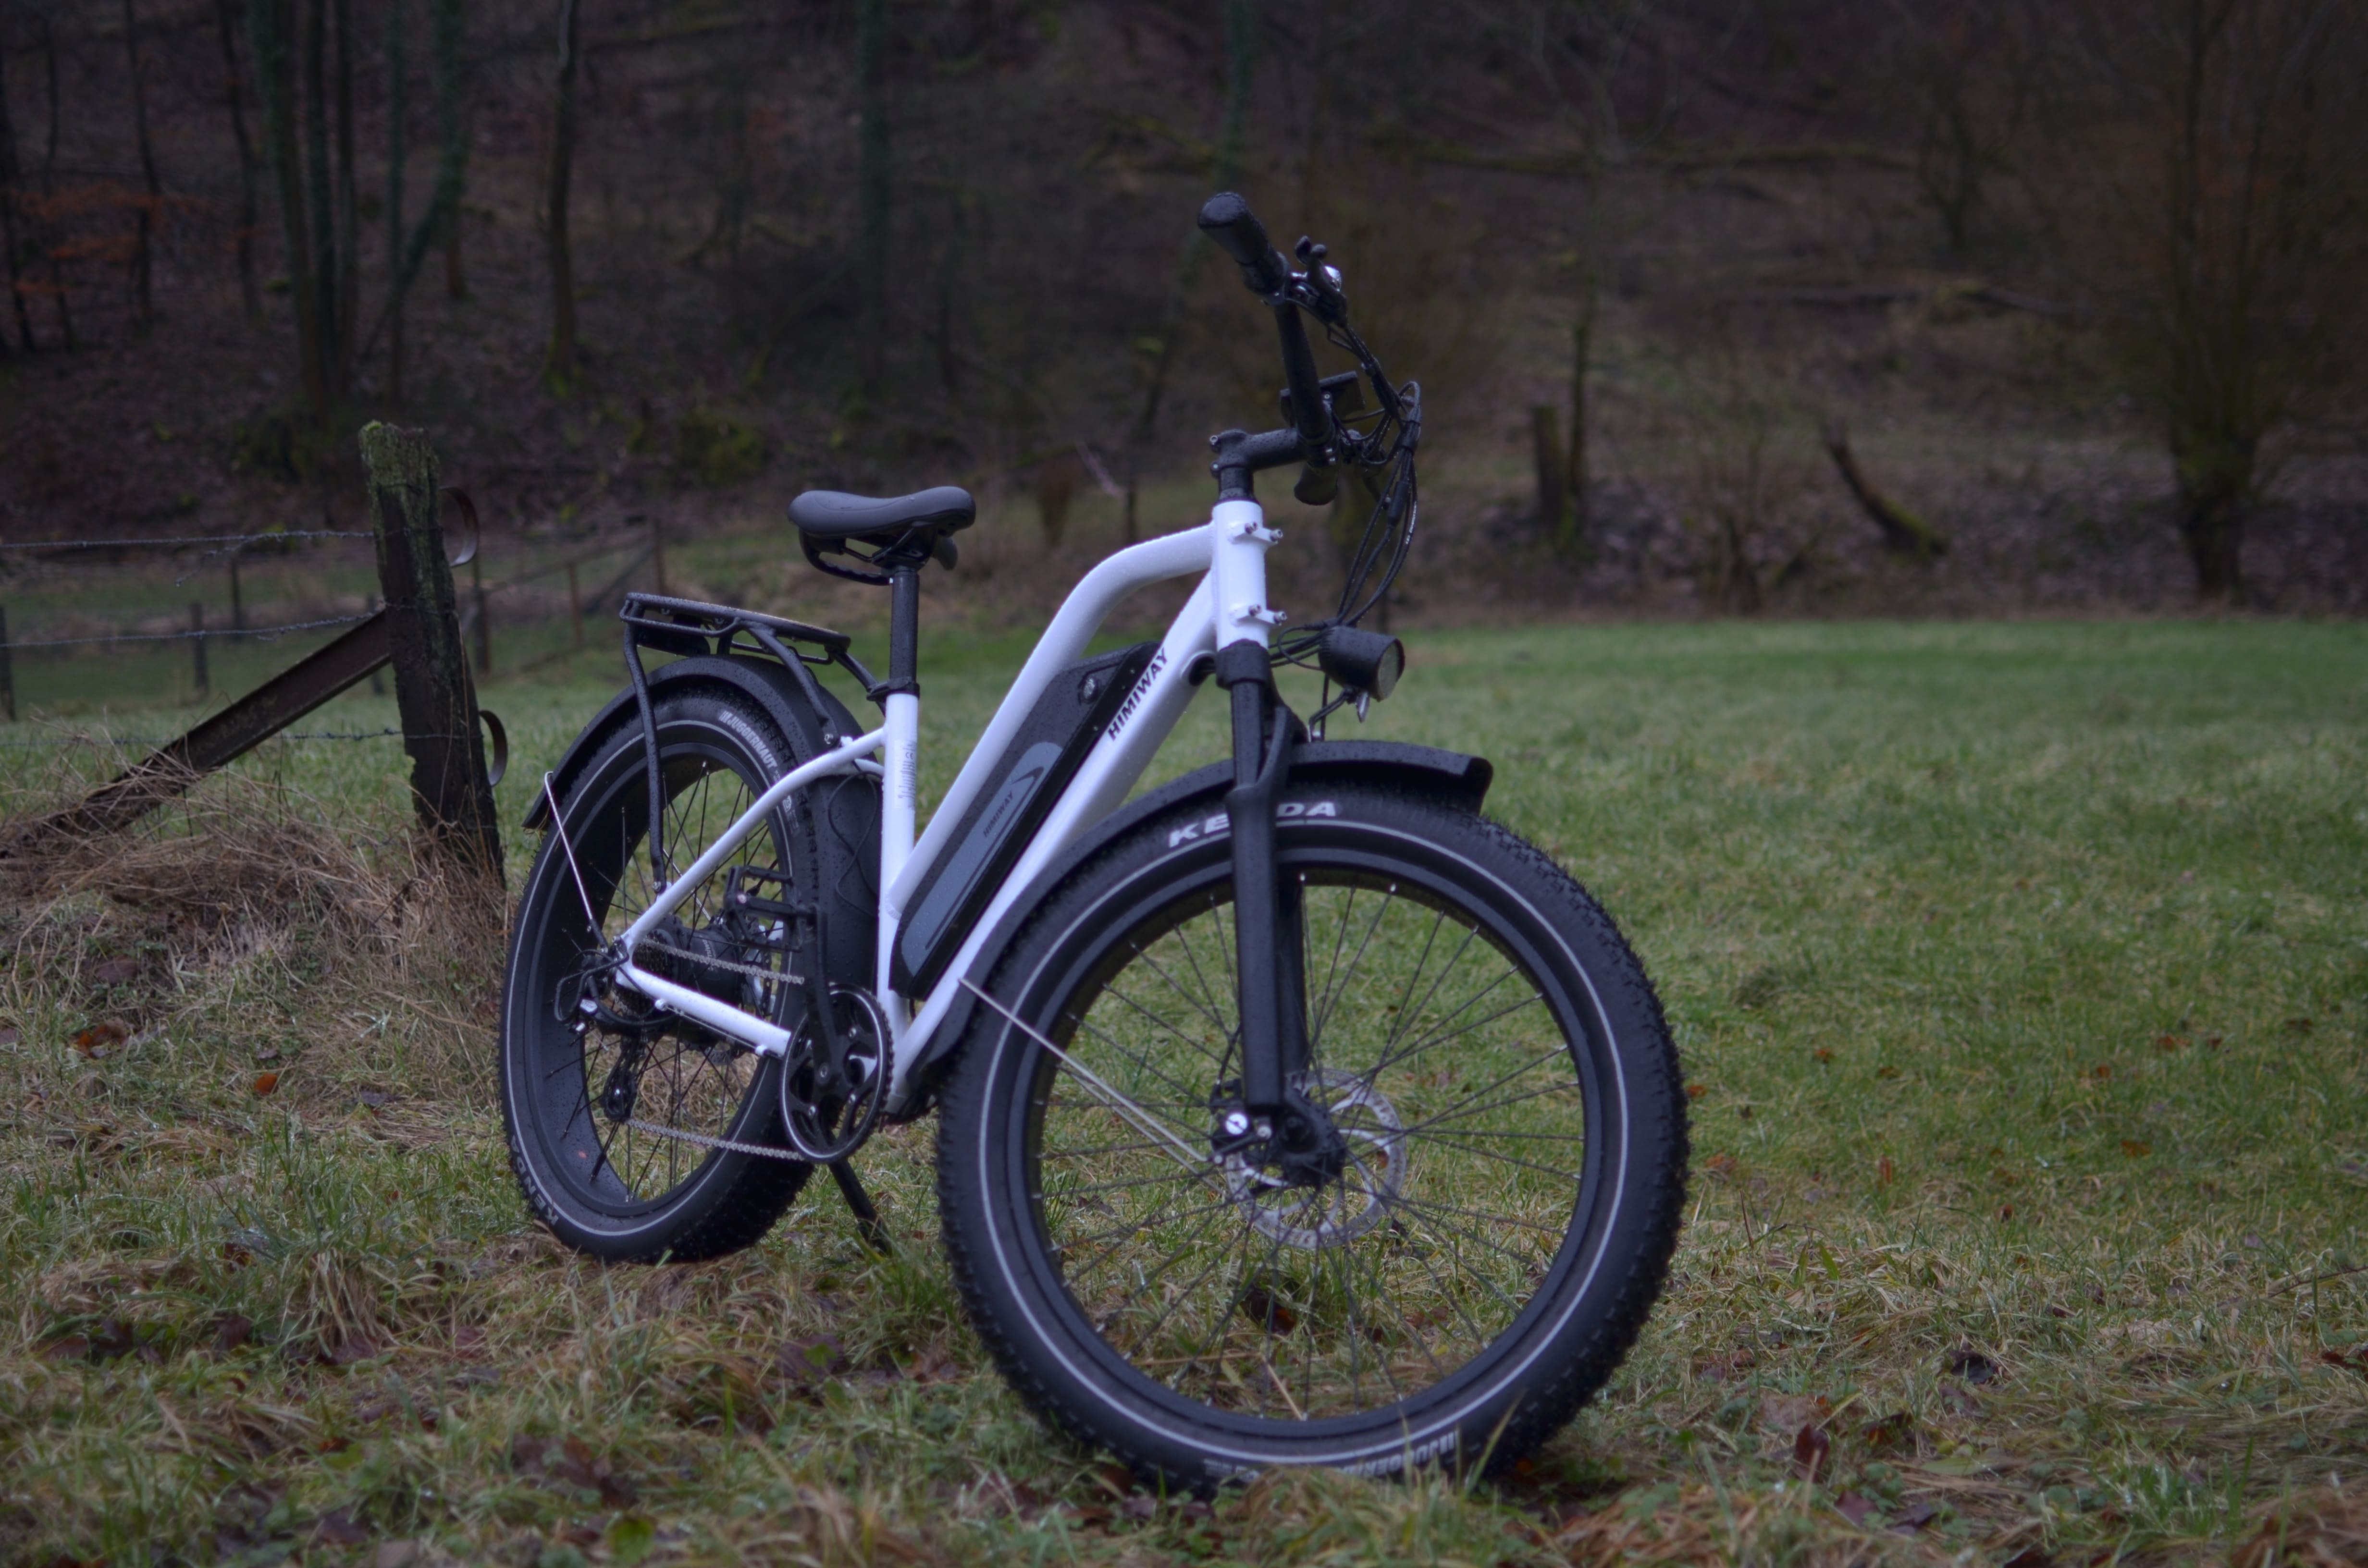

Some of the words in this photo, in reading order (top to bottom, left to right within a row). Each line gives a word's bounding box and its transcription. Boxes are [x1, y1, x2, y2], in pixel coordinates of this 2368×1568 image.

[1108, 647, 1167, 741] HIMIWAY
[726, 716, 778, 769] JUGGERNAUT
[983, 790, 1013, 838] HIMIWAY
[1168, 801, 1336, 848] KEDA
[511, 1135, 559, 1226] KENDA
